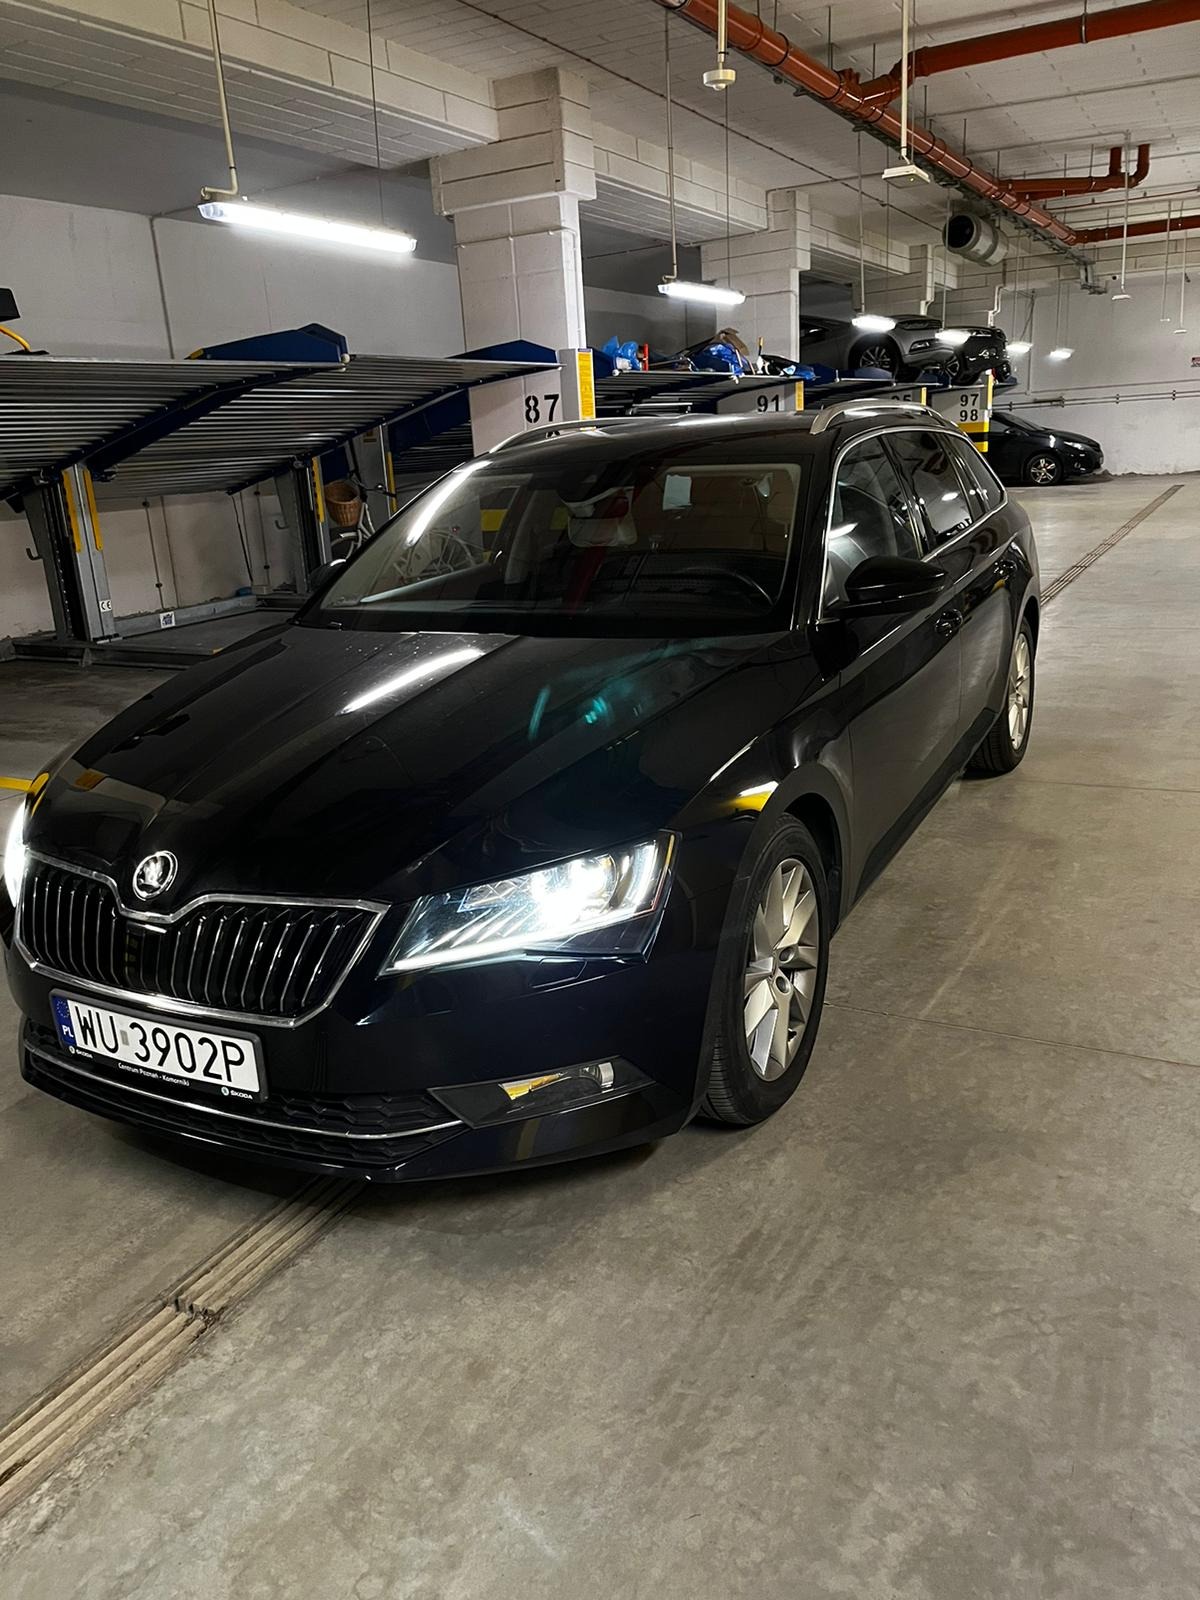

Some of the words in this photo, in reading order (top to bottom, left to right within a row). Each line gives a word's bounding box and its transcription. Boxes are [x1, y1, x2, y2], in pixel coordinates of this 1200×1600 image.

[757, 394, 779, 412] 91
[960, 393, 979, 407] 97
[525, 394, 560, 424] 87
[960, 409, 978, 422] 98
[61, 1024, 75, 1038] PL
[74, 1005, 119, 1054] WU
[129, 1021, 246, 1083] 3902P
[118, 1062, 140, 1074] Centrum
